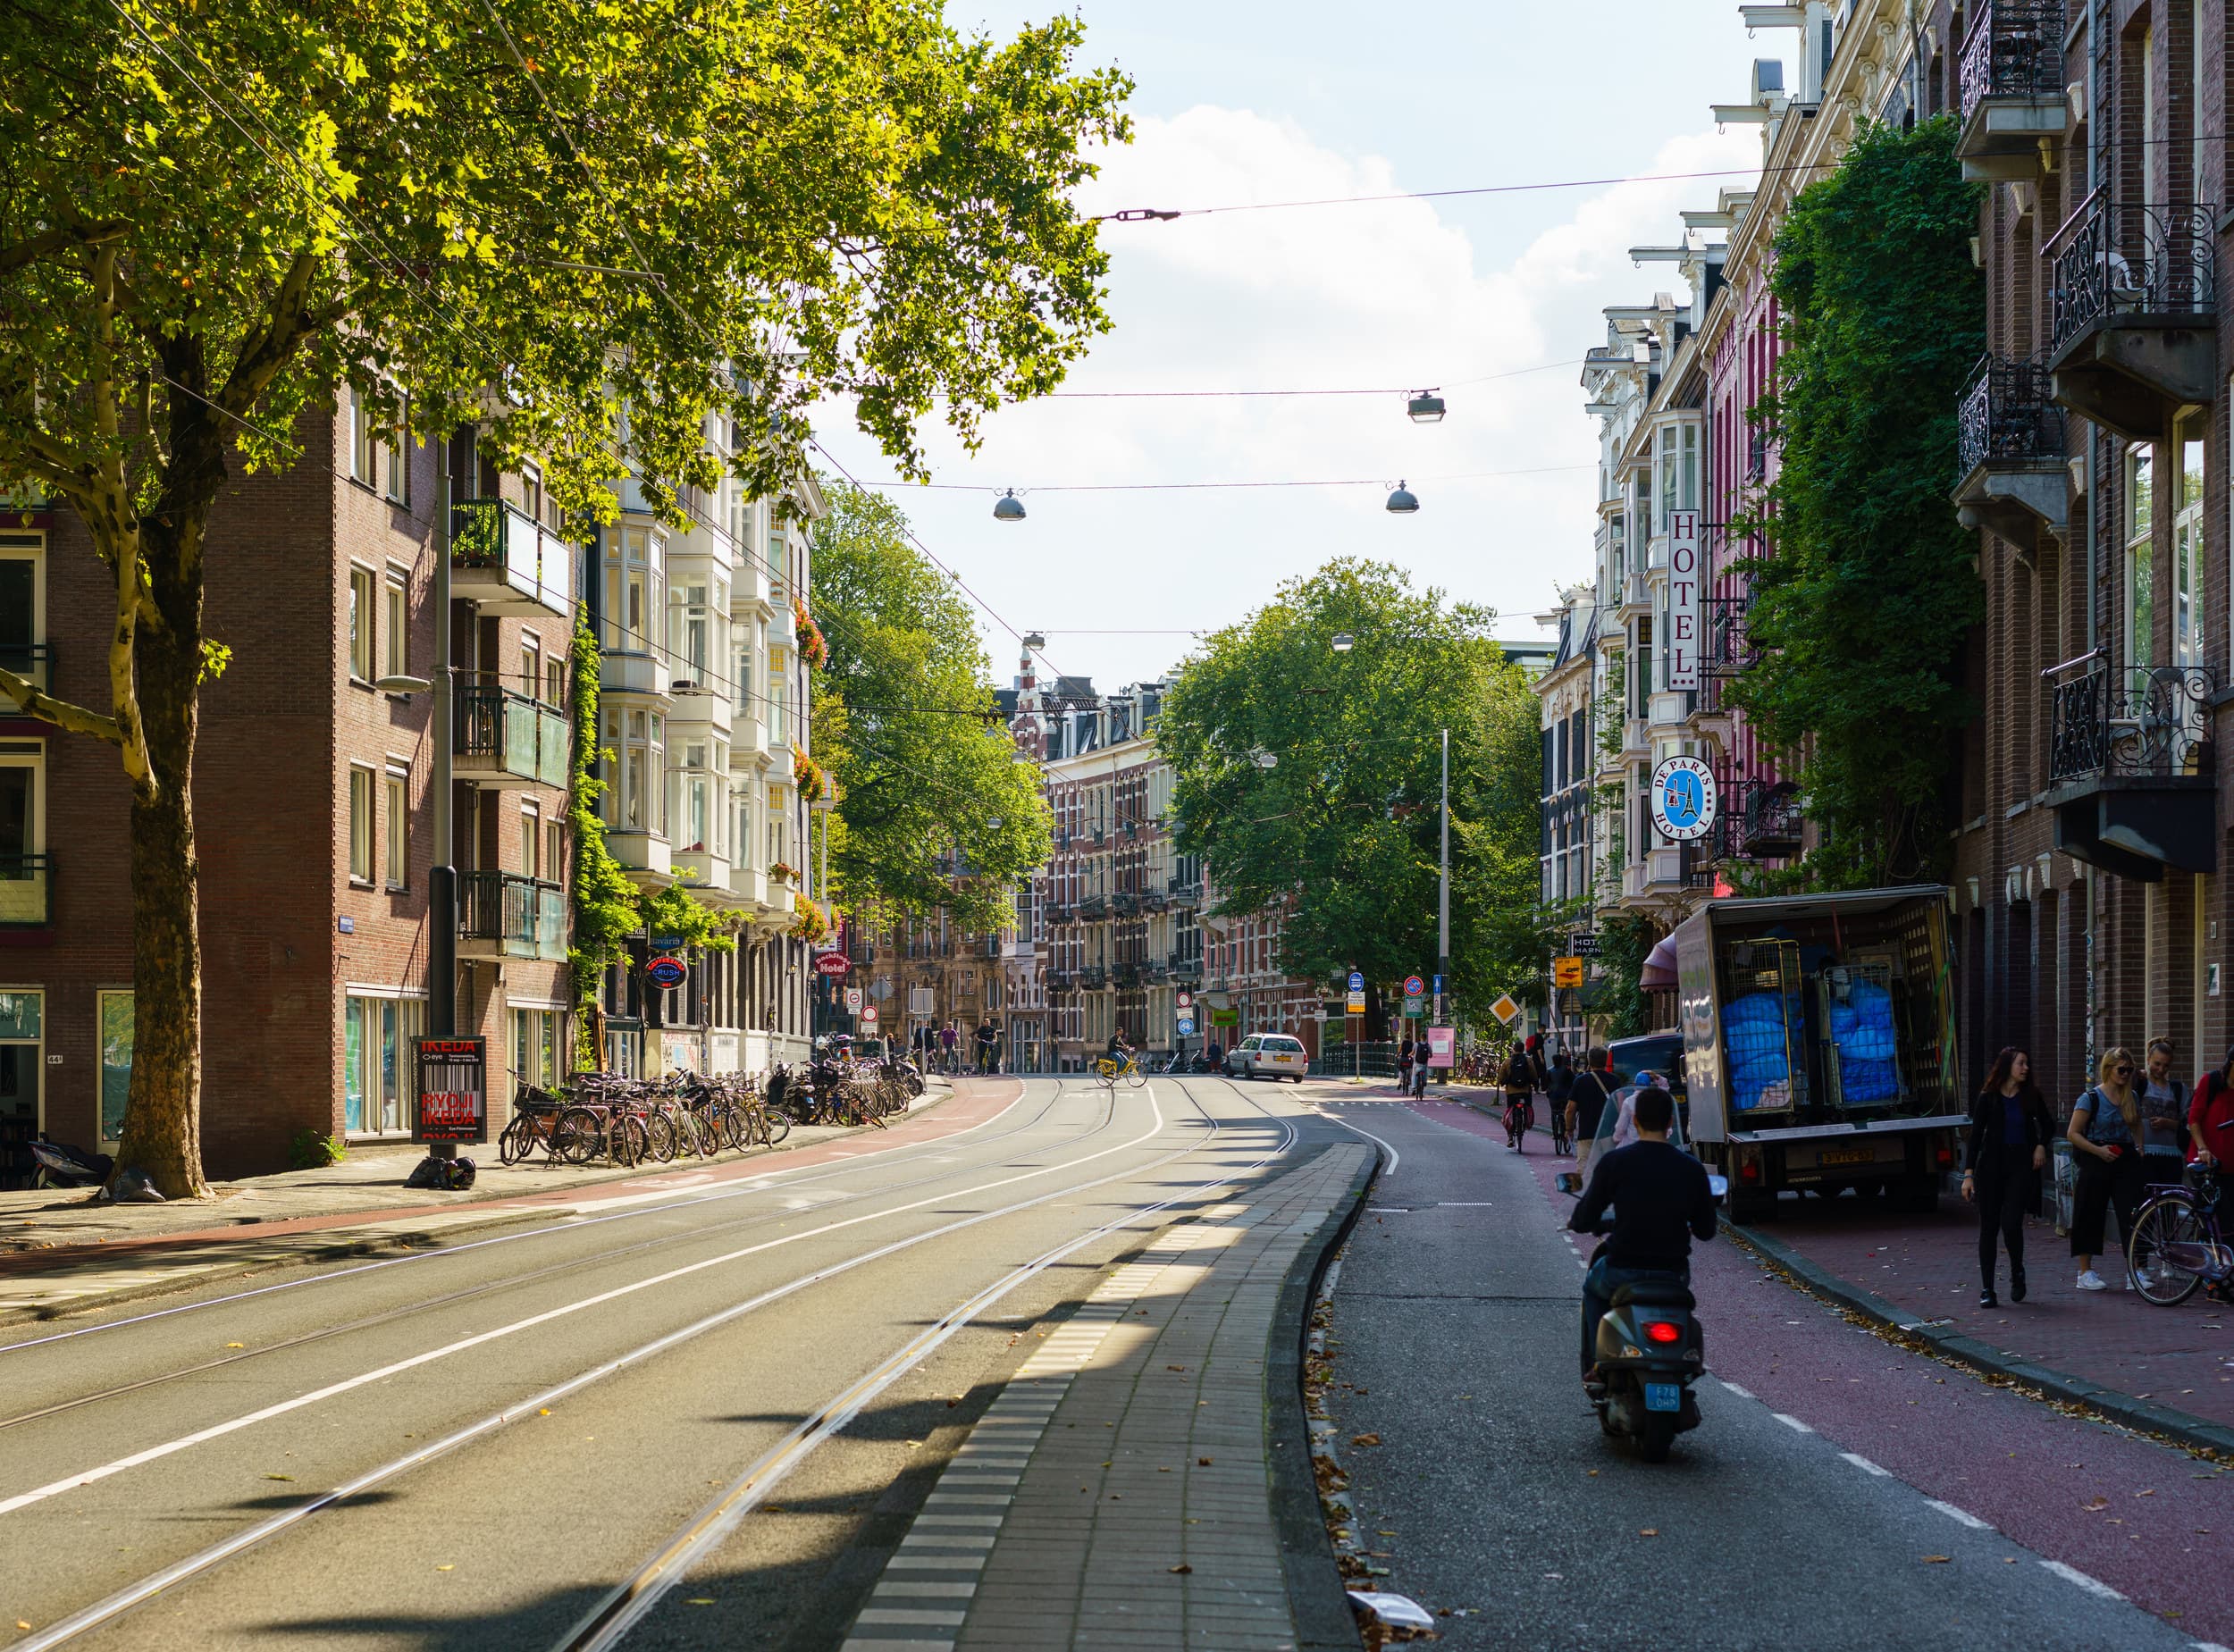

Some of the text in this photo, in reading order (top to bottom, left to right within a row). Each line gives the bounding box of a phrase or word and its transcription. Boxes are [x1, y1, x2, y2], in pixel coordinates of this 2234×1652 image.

[1673, 515, 1695, 674] HOTEL
[1654, 759, 1712, 788] DE PARIS
[1655, 812, 1709, 838] HOTEL
[647, 957, 686, 971] COFFEESHOP
[819, 963, 846, 973] Hotel
[651, 969, 680, 977] CRUSH
[422, 1041, 475, 1052] IKEDA
[422, 1094, 474, 1109] RYOJI
[422, 1111, 475, 1125] IKEDA
